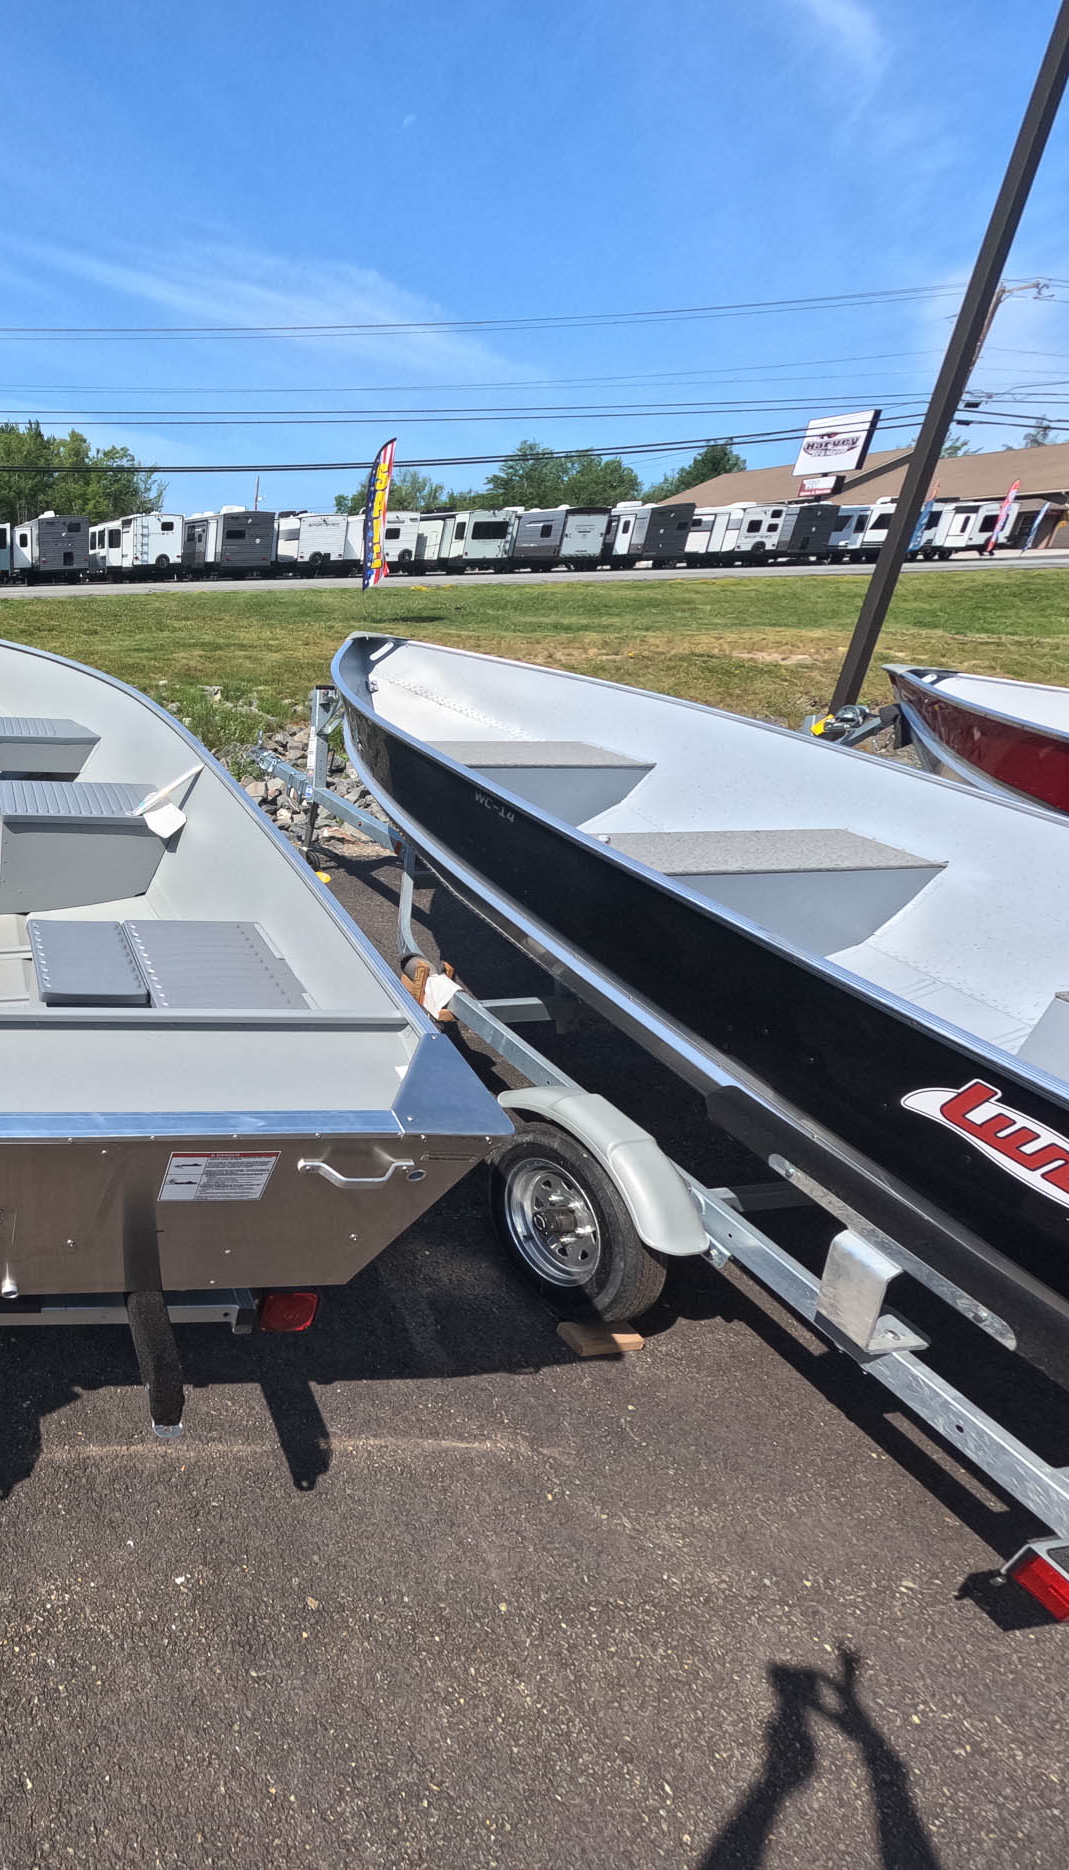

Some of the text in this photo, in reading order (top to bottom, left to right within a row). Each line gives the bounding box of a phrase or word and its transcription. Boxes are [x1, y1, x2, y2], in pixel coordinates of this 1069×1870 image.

[804, 435, 860, 451] Harvey
[370, 463, 389, 569] SALE
[475, 789, 515, 822] WC-14
